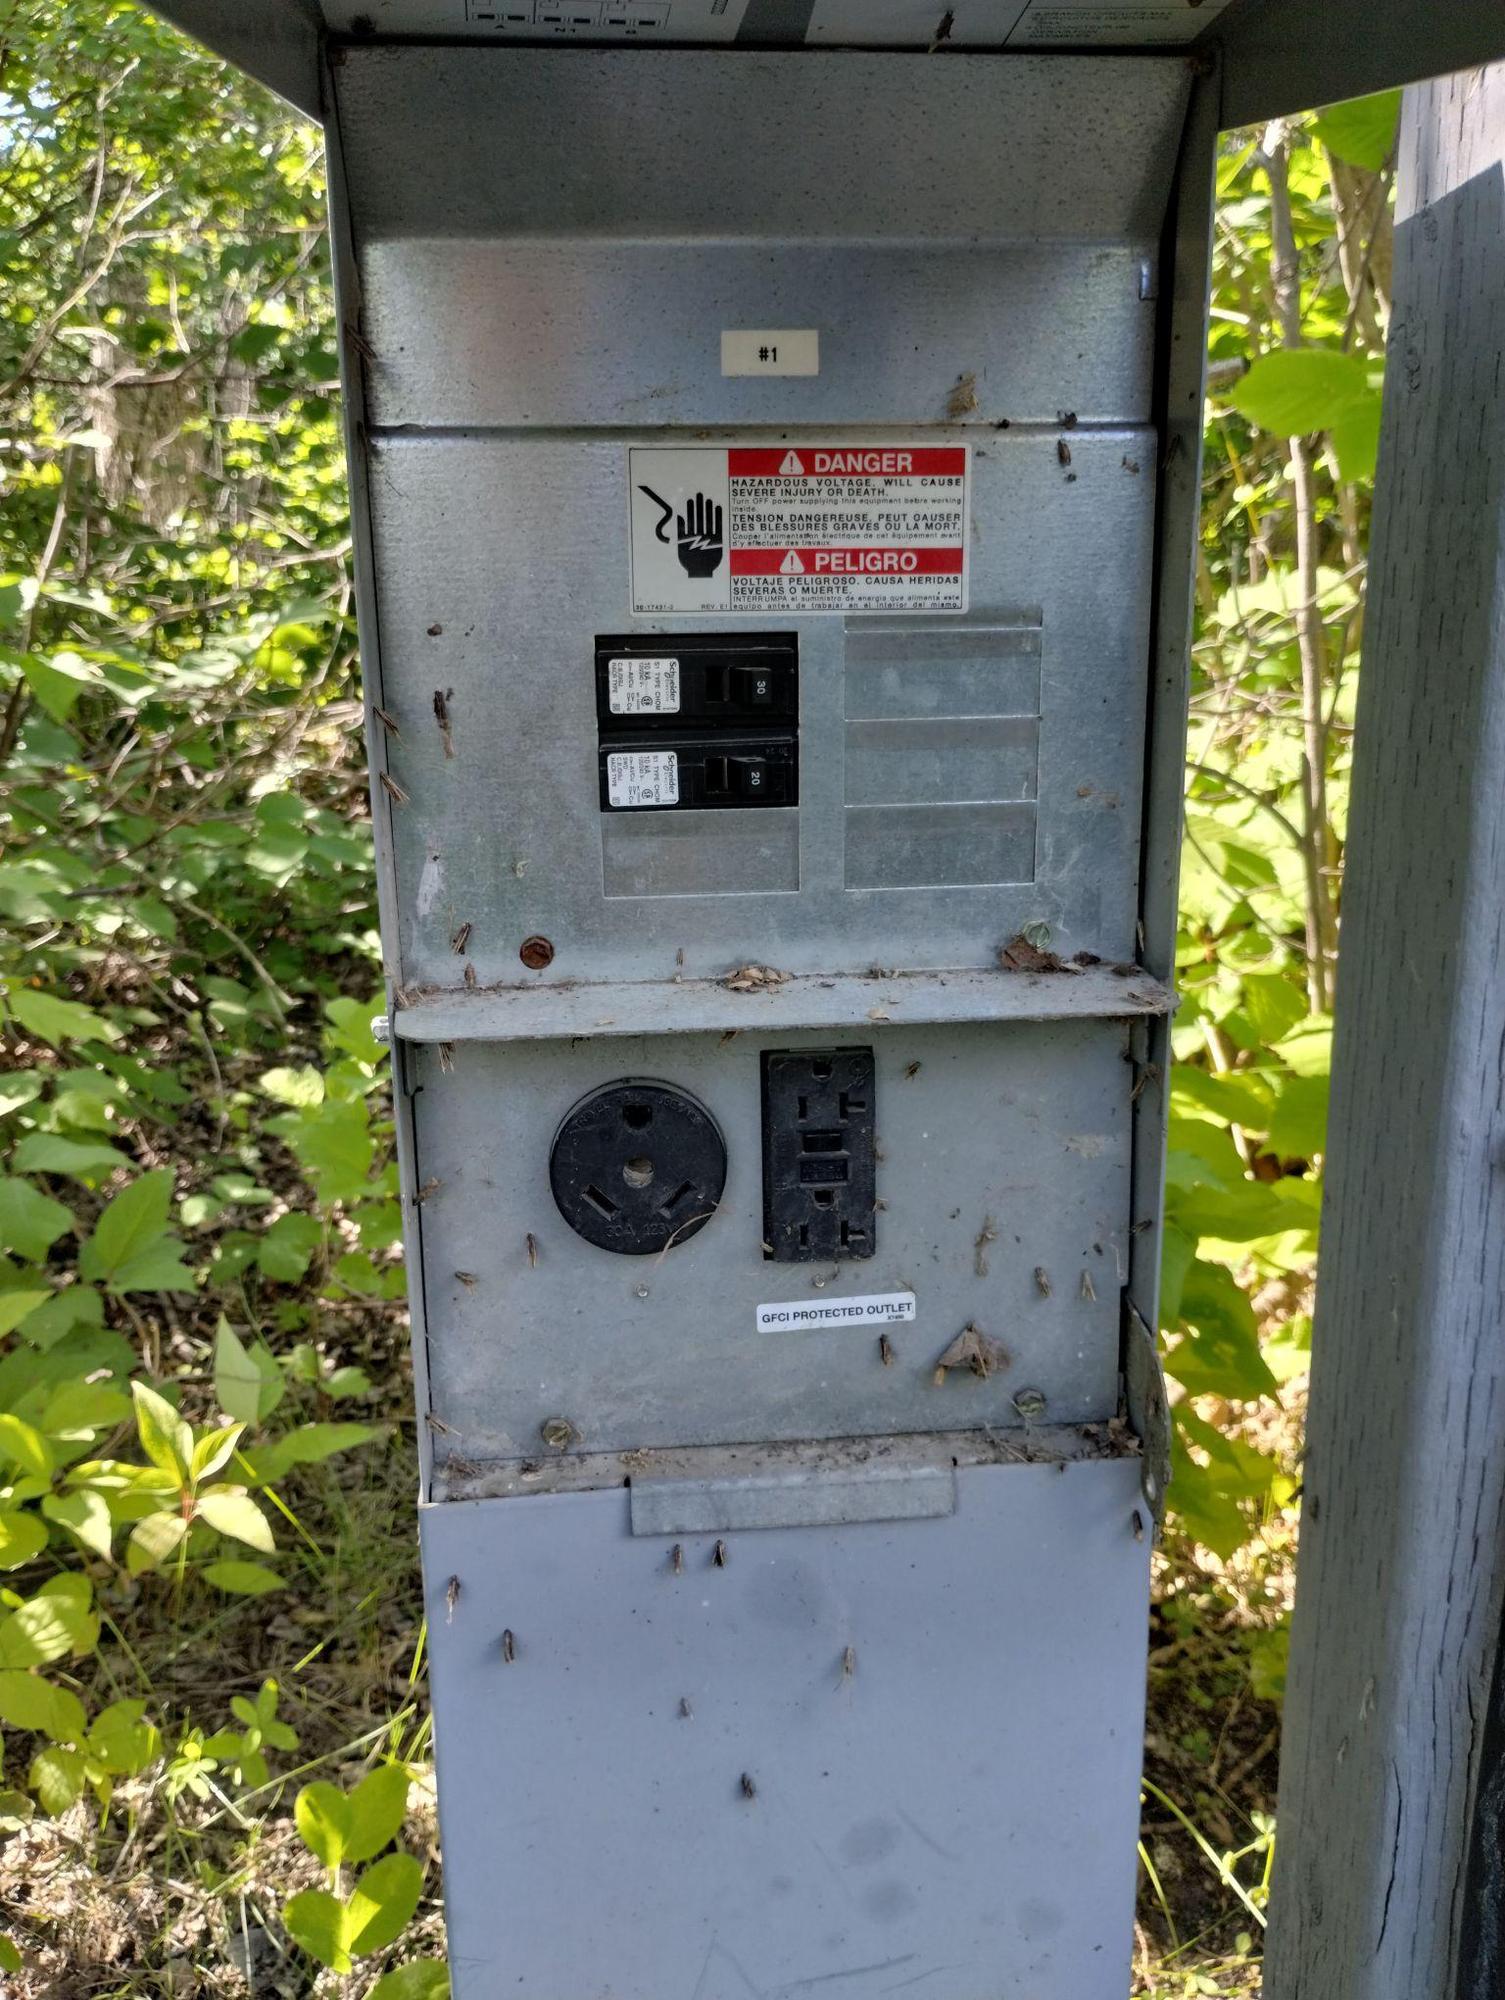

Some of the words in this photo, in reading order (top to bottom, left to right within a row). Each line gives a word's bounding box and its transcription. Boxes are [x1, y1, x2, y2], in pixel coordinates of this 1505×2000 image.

[758, 346, 777, 363] #1
[814, 453, 913, 473] DANGER
[731, 478, 809, 488] HAZARDOUS
[883, 478, 913, 487] WILL
[920, 478, 961, 487] CAUSE
[731, 488, 776, 497] SEVERE
[780, 488, 823, 497] INJURY
[827, 488, 843, 497] OR
[847, 488, 889, 497] DEATH.
[732, 497, 750, 505] Turn
[752, 497, 769, 505] OFF
[772, 498, 797, 506] power
[800, 497, 839, 506] supplying
[860, 497, 901, 506] equipment
[931, 497, 962, 506] working
[732, 514, 784, 523] TENSION
[878, 513, 908, 522] PEUT
[913, 513, 961, 522] CAUSER
[732, 522, 755, 532] DES
[760, 522, 828, 532] BLESSURES
[833, 522, 880, 531] GRAVES
[884, 522, 901, 531] OU
[906, 522, 920, 531] LA
[924, 522, 961, 531] MORT.
[732, 532, 761, 541] Couper
[815, 552, 918, 572] PELIGRO
[732, 577, 783, 586] VOLTAJE
[788, 577, 860, 586] PELIGROSO.
[865, 576, 904, 585] CAUSA
[909, 576, 959, 585] HERIDAS
[732, 586, 785, 596] SEVERAS
[788, 586, 797, 595] O
[801, 586, 853, 595] MUERTE.
[732, 595, 787, 603] INTERRUMPA
[890, 595, 904, 603] que
[733, 603, 763, 611] equipo
[669, 661, 678, 702] Schneider
[756, 680, 766, 695] 30
[667, 754, 676, 795] Schneider
[750, 771, 761, 786] 20
[761, 1312, 791, 1324] GFCI
[792, 1306, 864, 1321] PROTECTED
[866, 1302, 913, 1315] OUTLET
